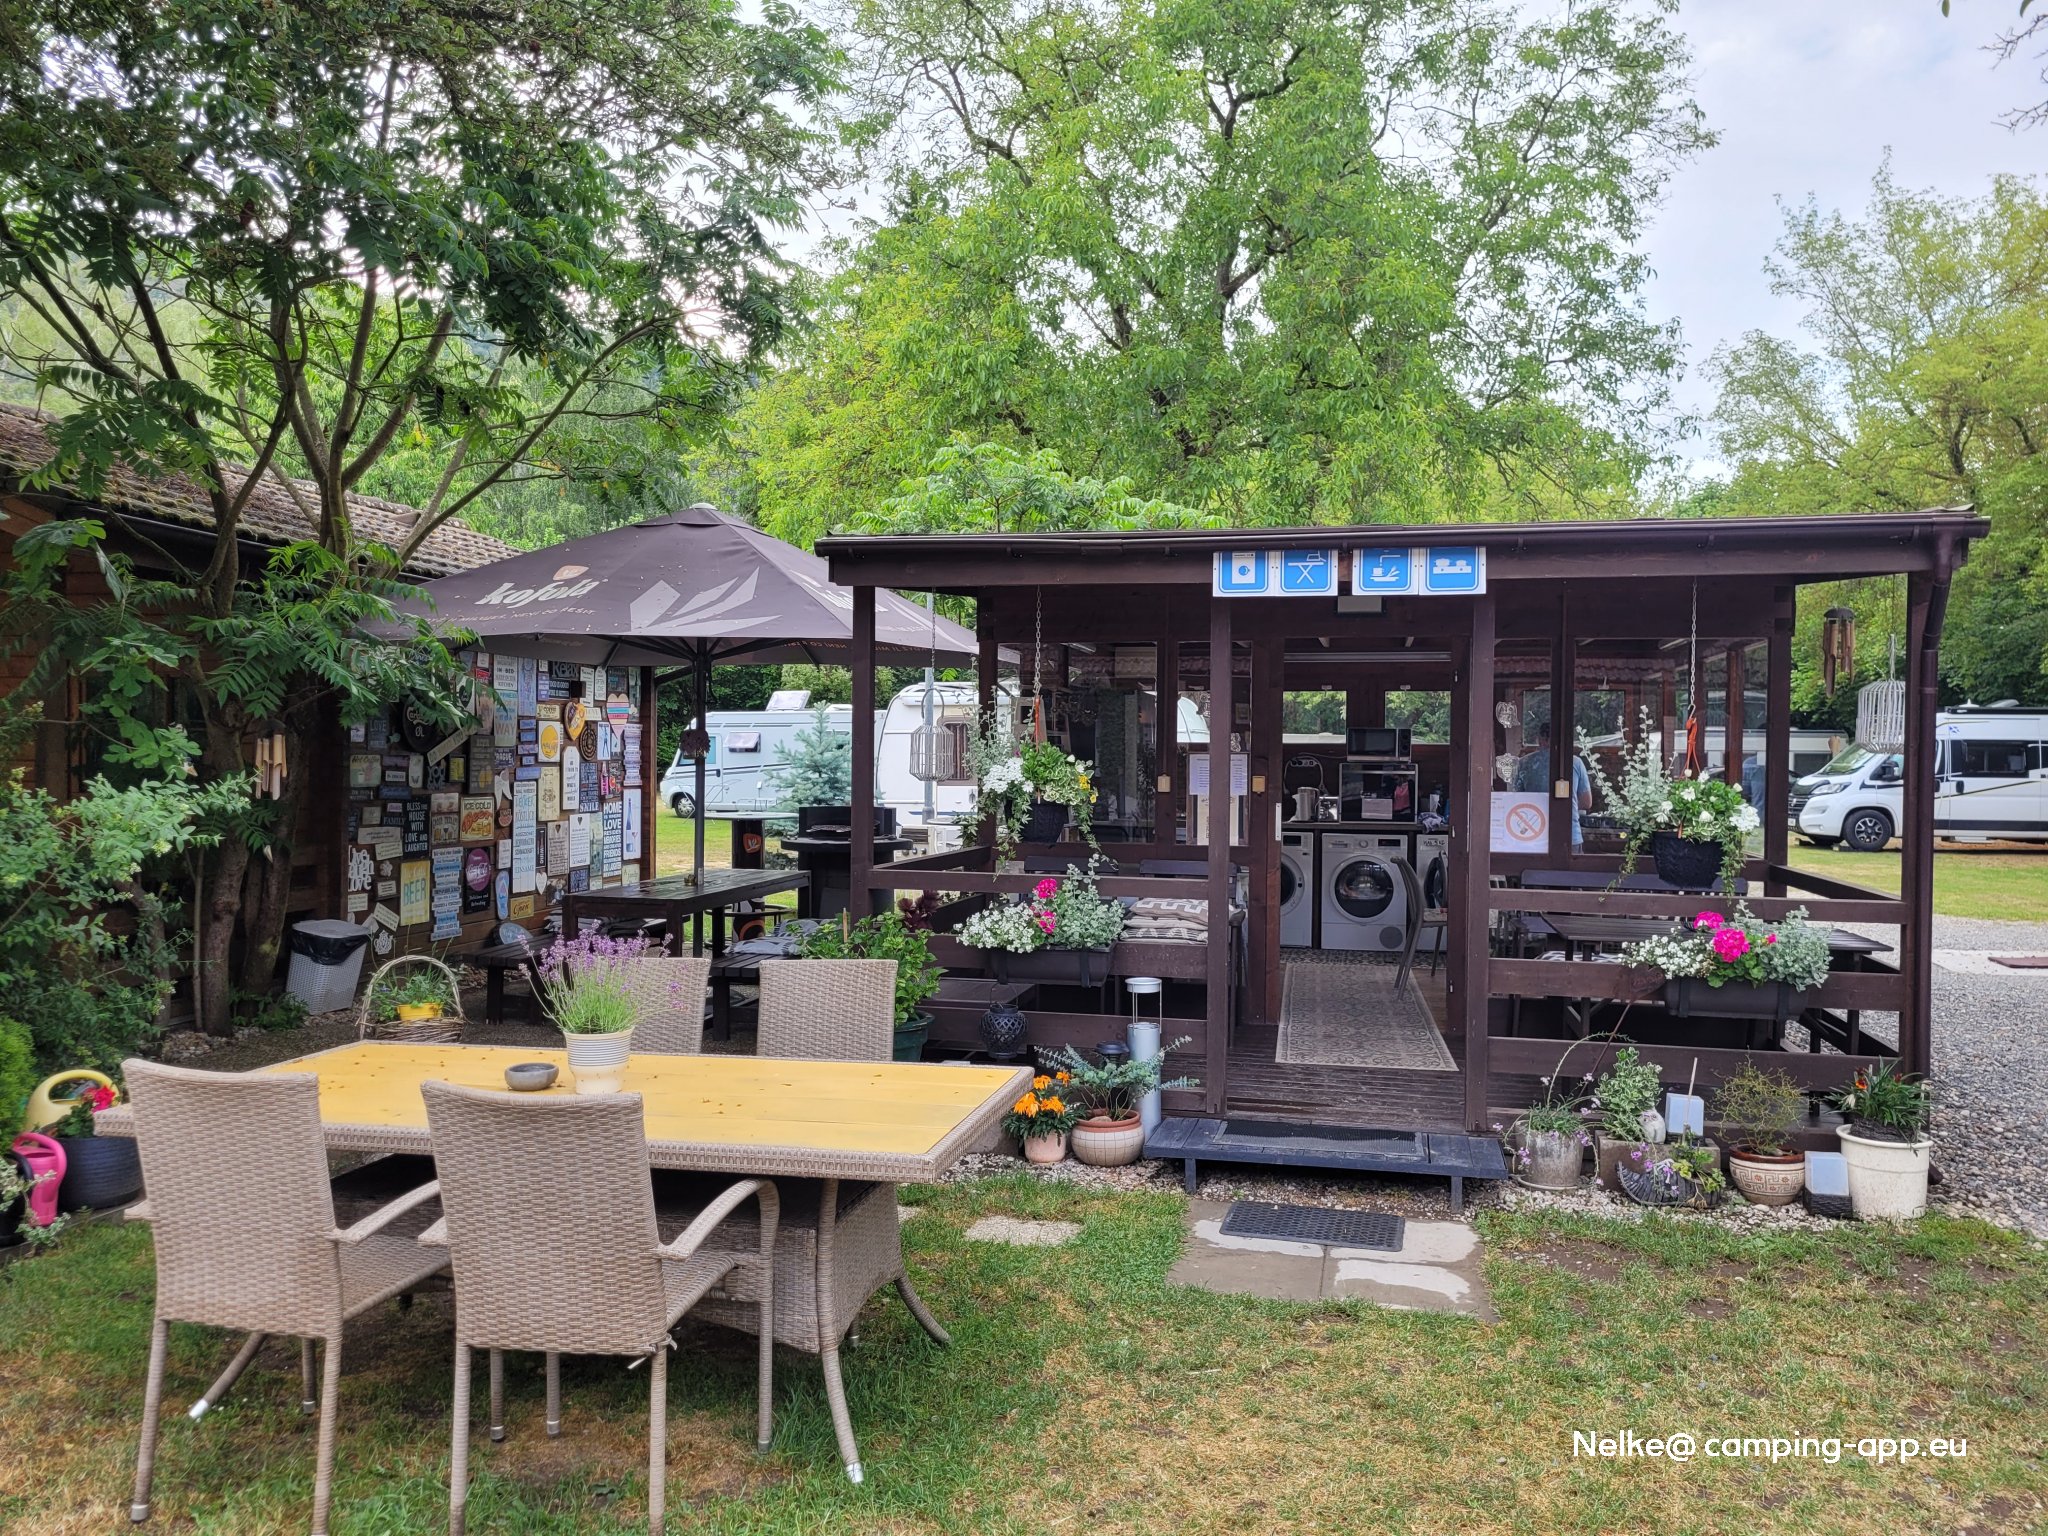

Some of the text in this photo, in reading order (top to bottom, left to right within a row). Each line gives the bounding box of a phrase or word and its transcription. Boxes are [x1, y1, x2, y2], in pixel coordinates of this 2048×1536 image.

[474, 578, 600, 609] kofola
[552, 660, 579, 679] Relax
[495, 722, 516, 736] WAY
[406, 803, 420, 811] BLESS
[464, 801, 492, 810] ICE COLD
[603, 801, 622, 814] HOME
[383, 817, 405, 825] FAMILY
[408, 811, 426, 822] HOUSE
[411, 822, 424, 831] WITH
[603, 819, 622, 831] LOVE
[405, 833, 418, 843] LOVE
[405, 843, 428, 853] LAUGHTER
[403, 878, 427, 906] BEER
[513, 903, 530, 916] Open
